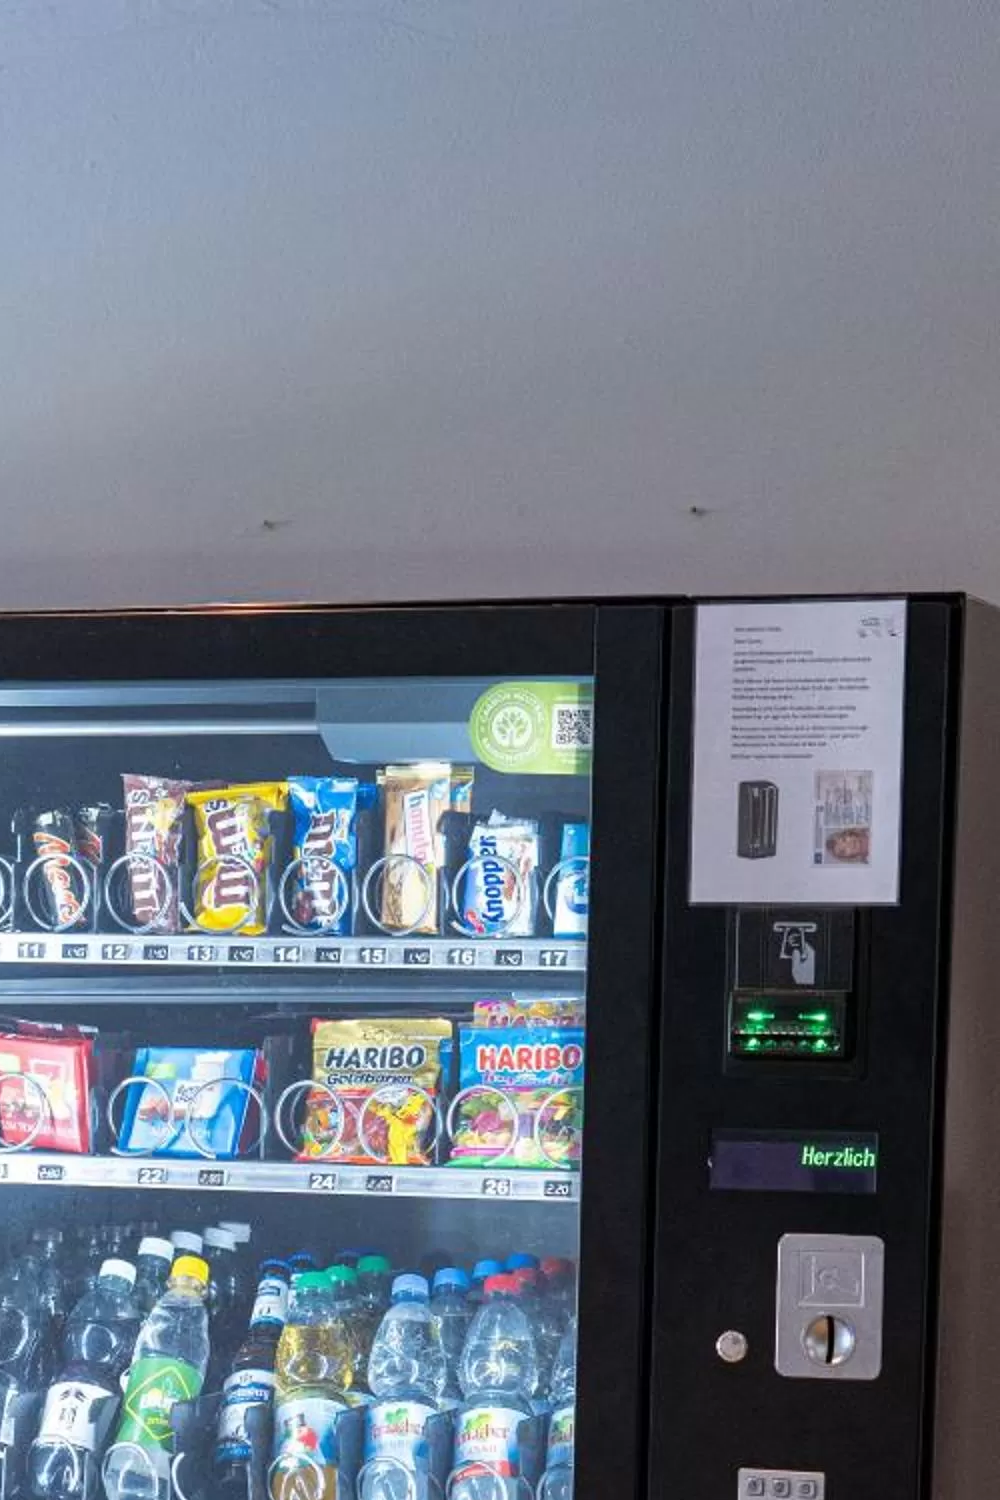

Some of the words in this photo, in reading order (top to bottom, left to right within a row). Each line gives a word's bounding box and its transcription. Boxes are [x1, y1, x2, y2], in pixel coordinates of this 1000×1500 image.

[19, 942, 41, 958] 11
[103, 944, 126, 960] 12
[188, 945, 213, 961] 13
[275, 947, 300, 962] 14
[360, 948, 384, 963] 15
[450, 949, 474, 965] 16
[540, 950, 564, 966] 17
[325, 1045, 426, 1070] HARIBO
[477, 1044, 583, 1072] HARIBO
[801, 1145, 876, 1168] Herzlich
[139, 1168, 162, 1183] 22
[310, 1174, 335, 1190] 24
[483, 1179, 508, 1195] 26
